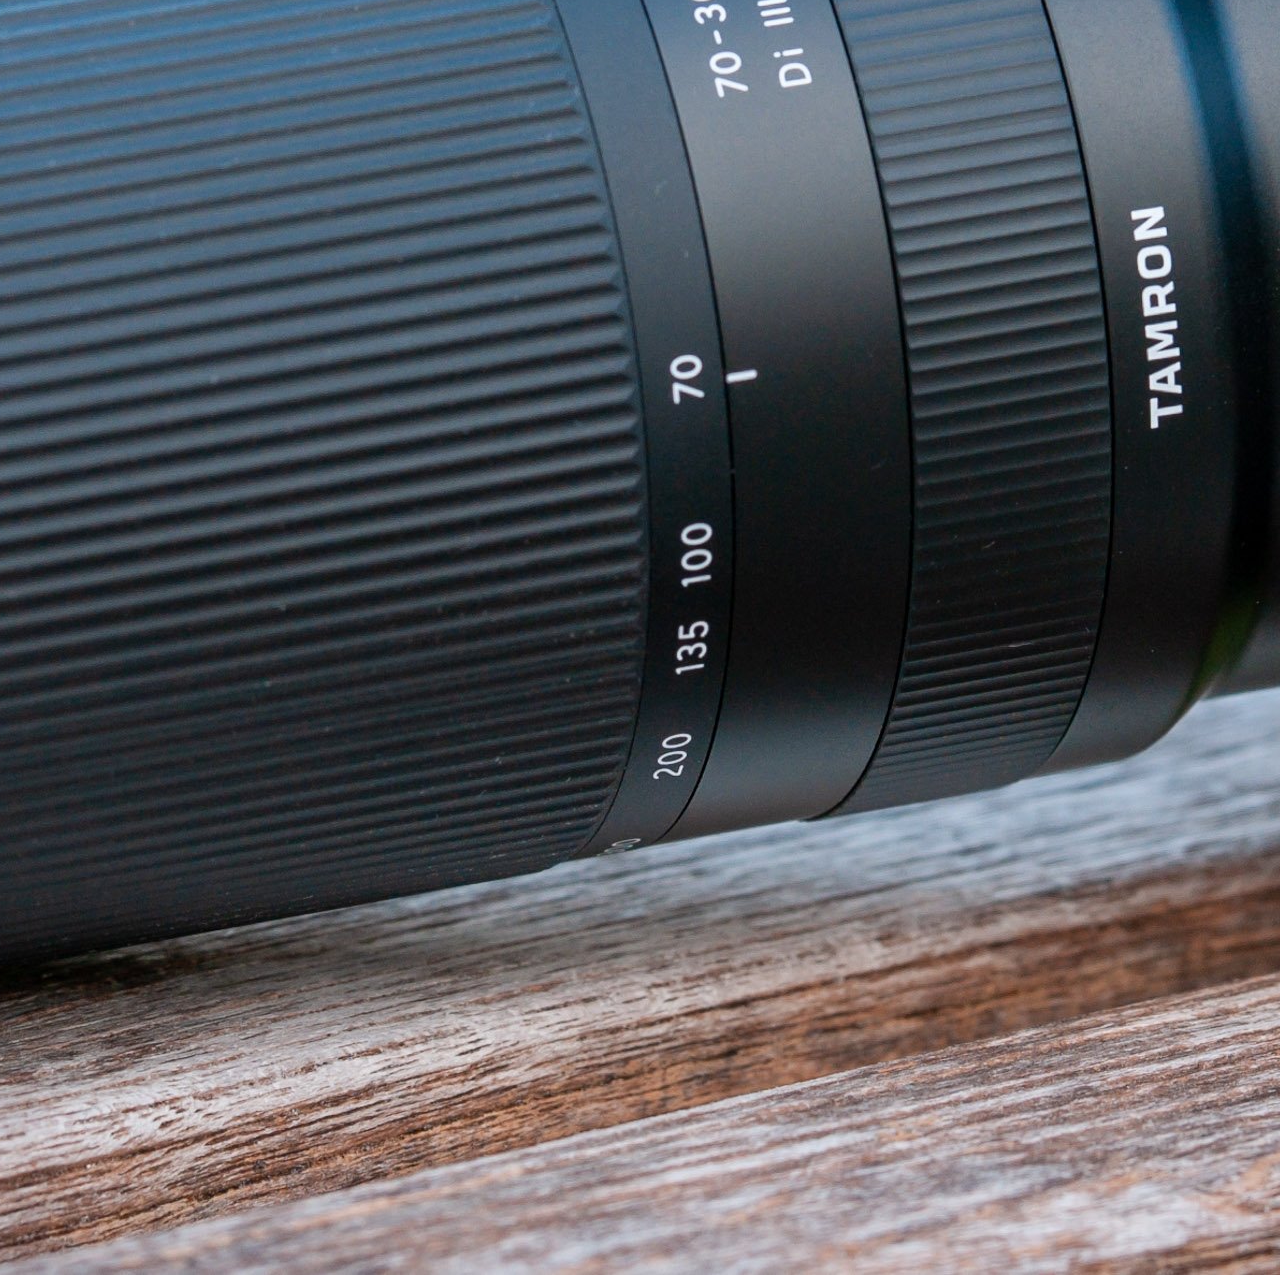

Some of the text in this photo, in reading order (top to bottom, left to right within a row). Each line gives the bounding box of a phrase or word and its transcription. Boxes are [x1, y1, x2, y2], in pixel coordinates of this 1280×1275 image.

[773, 47, 813, 88] Di
[1130, 205, 1184, 430] TAMRON
[669, 354, 705, 405] 70
[680, 522, 713, 587] 100
[675, 620, 710, 675] 135
[652, 733, 692, 780] 200
